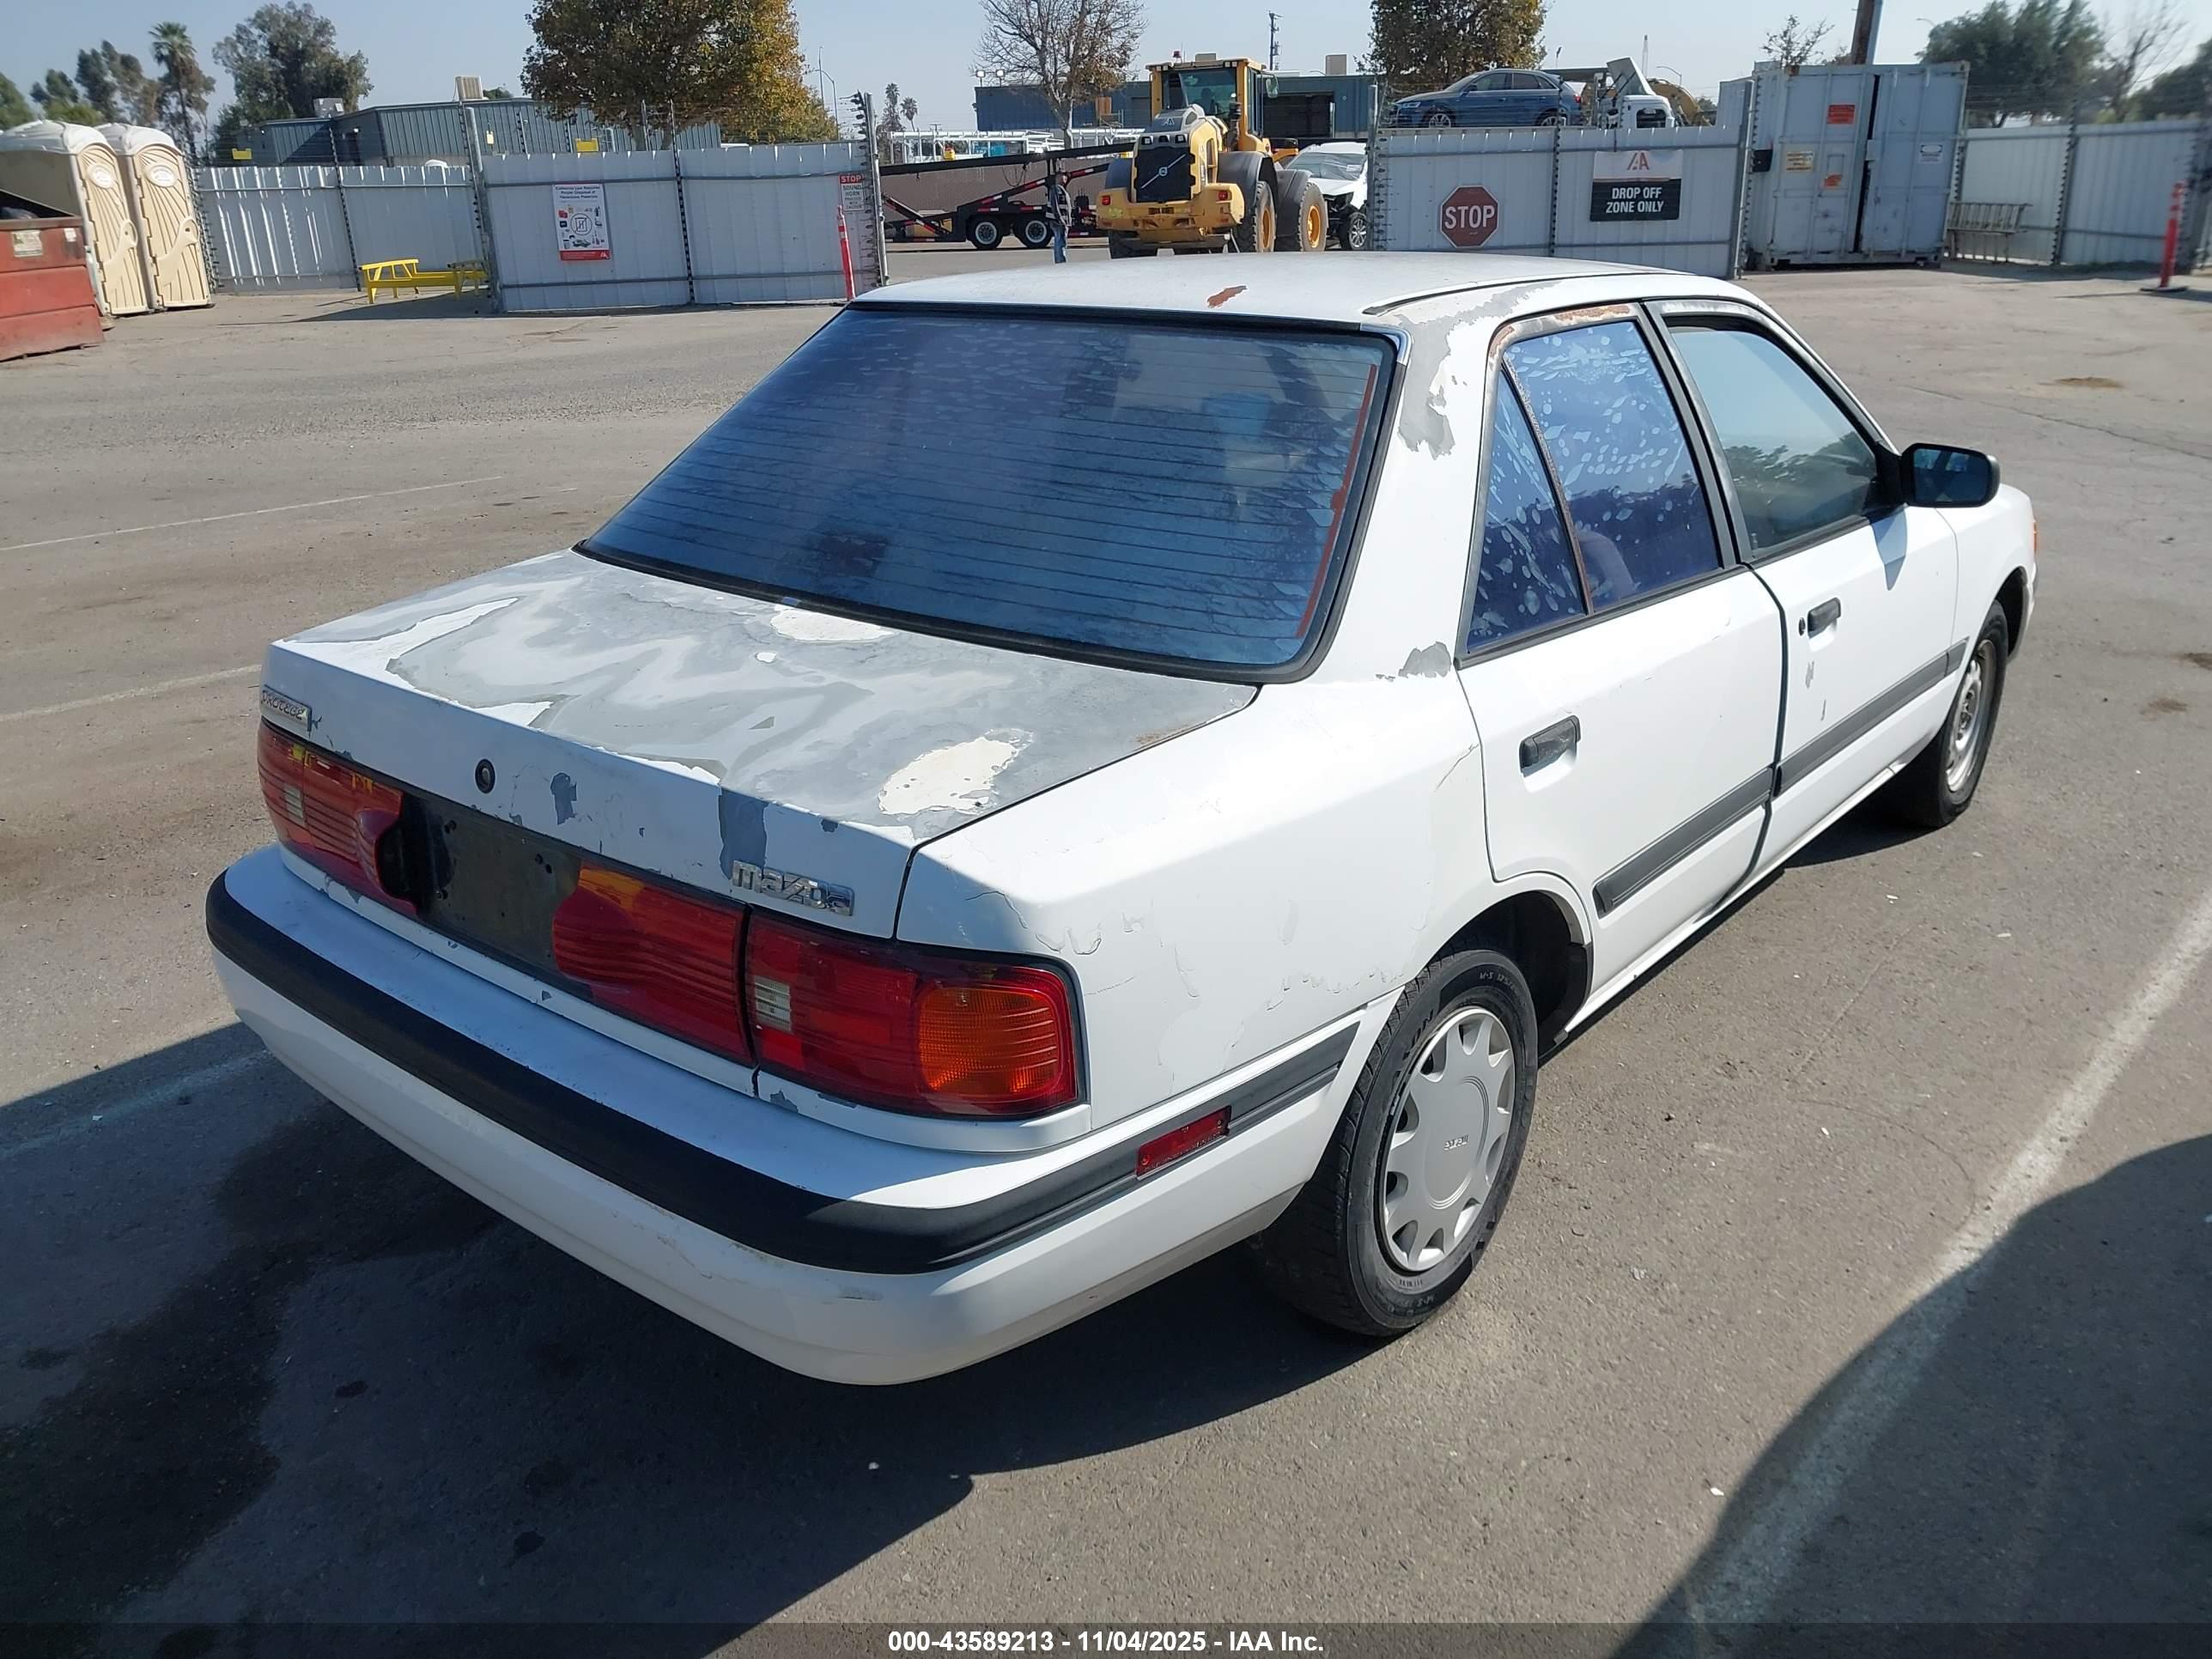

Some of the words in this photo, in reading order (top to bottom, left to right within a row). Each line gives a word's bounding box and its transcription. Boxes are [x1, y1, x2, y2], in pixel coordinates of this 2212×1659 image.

[841, 174, 861, 183] STOP
[1612, 187, 1640, 199] DROP
[1643, 186, 1662, 199] OFF
[1606, 201, 1635, 214] ZONE
[1638, 200, 1664, 213] ONLY
[1444, 204, 1495, 229] STOP
